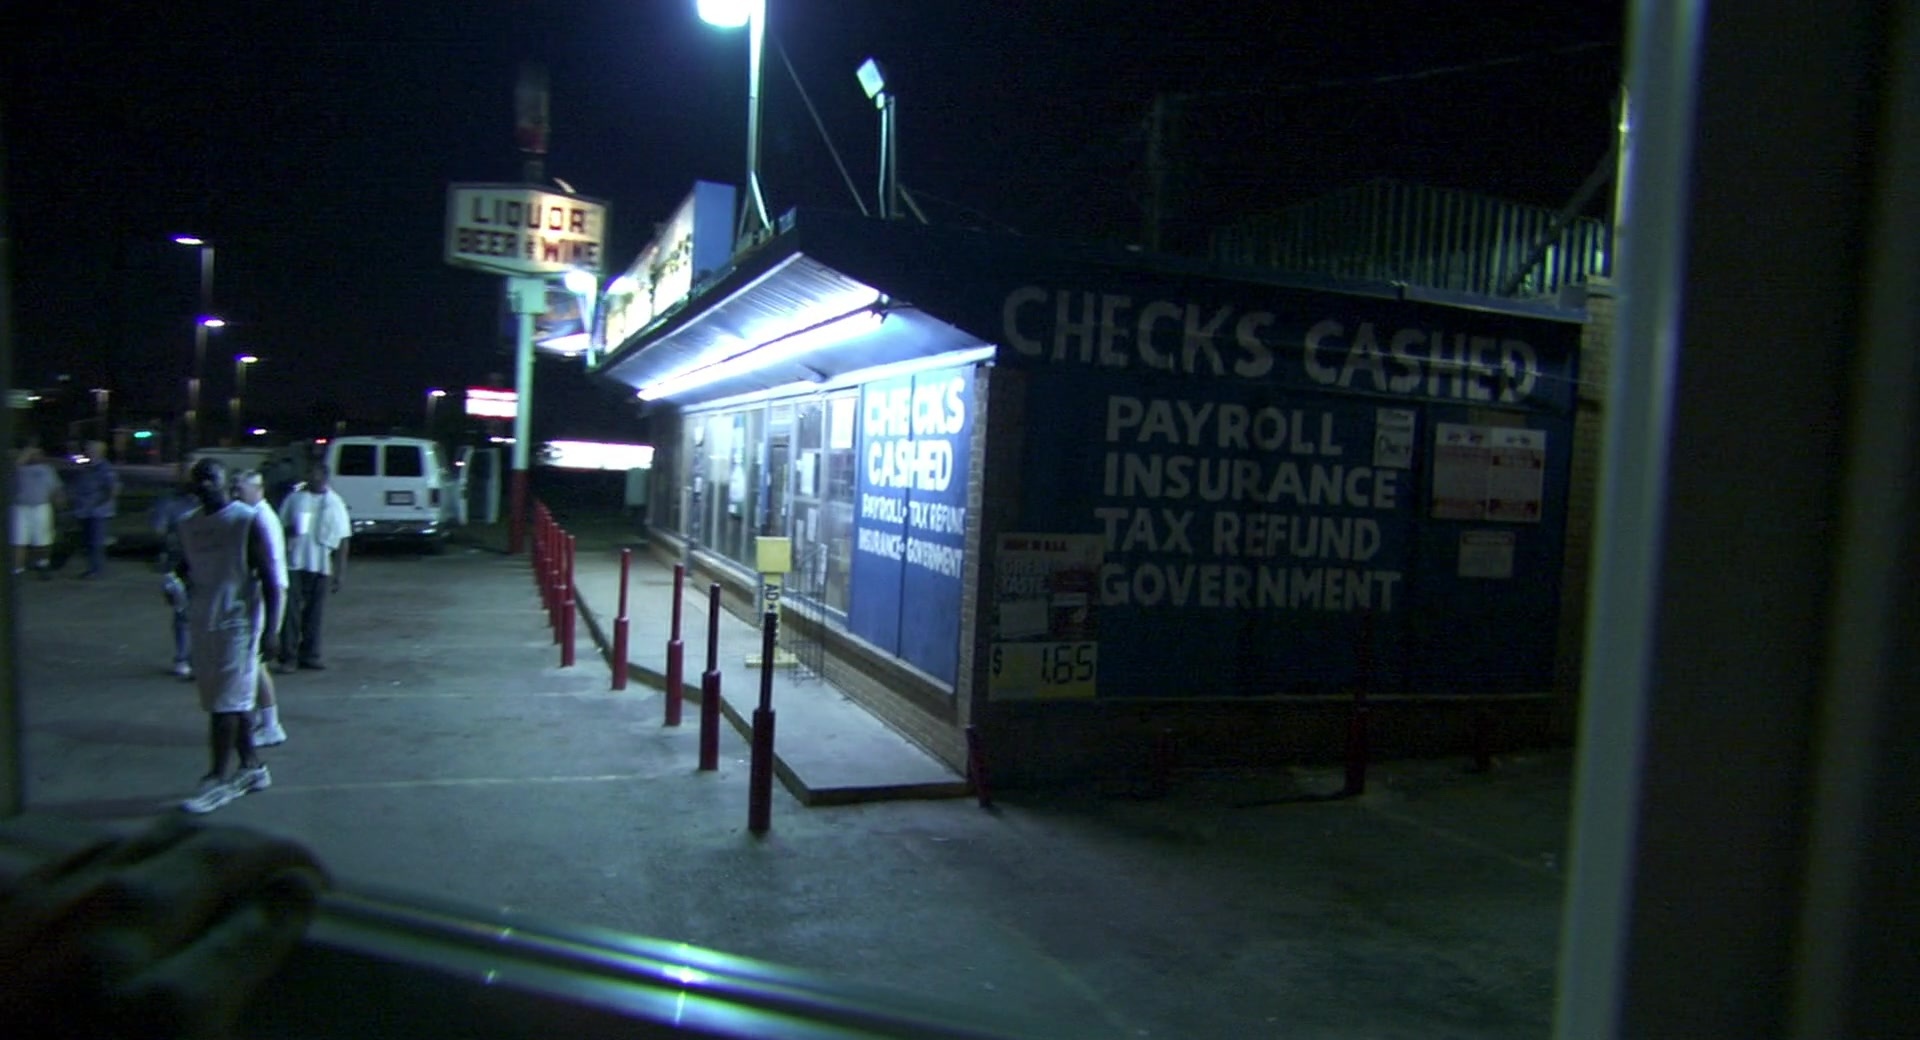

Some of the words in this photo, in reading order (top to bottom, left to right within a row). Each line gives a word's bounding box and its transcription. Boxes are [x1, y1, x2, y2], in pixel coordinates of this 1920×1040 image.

[457, 227, 517, 258] BEER
[473, 197, 585, 235] LIQUOR
[1002, 285, 1275, 378] CHECKS
[1303, 320, 1538, 402] CASHED
[862, 377, 965, 436] CHECKS
[1105, 396, 1343, 456] PAYROLL
[866, 440, 952, 491] CASHED
[1104, 453, 1397, 509] INSURANCE
[1093, 507, 1193, 553] TAX
[1213, 512, 1382, 562] REFUND
[1101, 562, 1402, 612] GOVERNMENT
